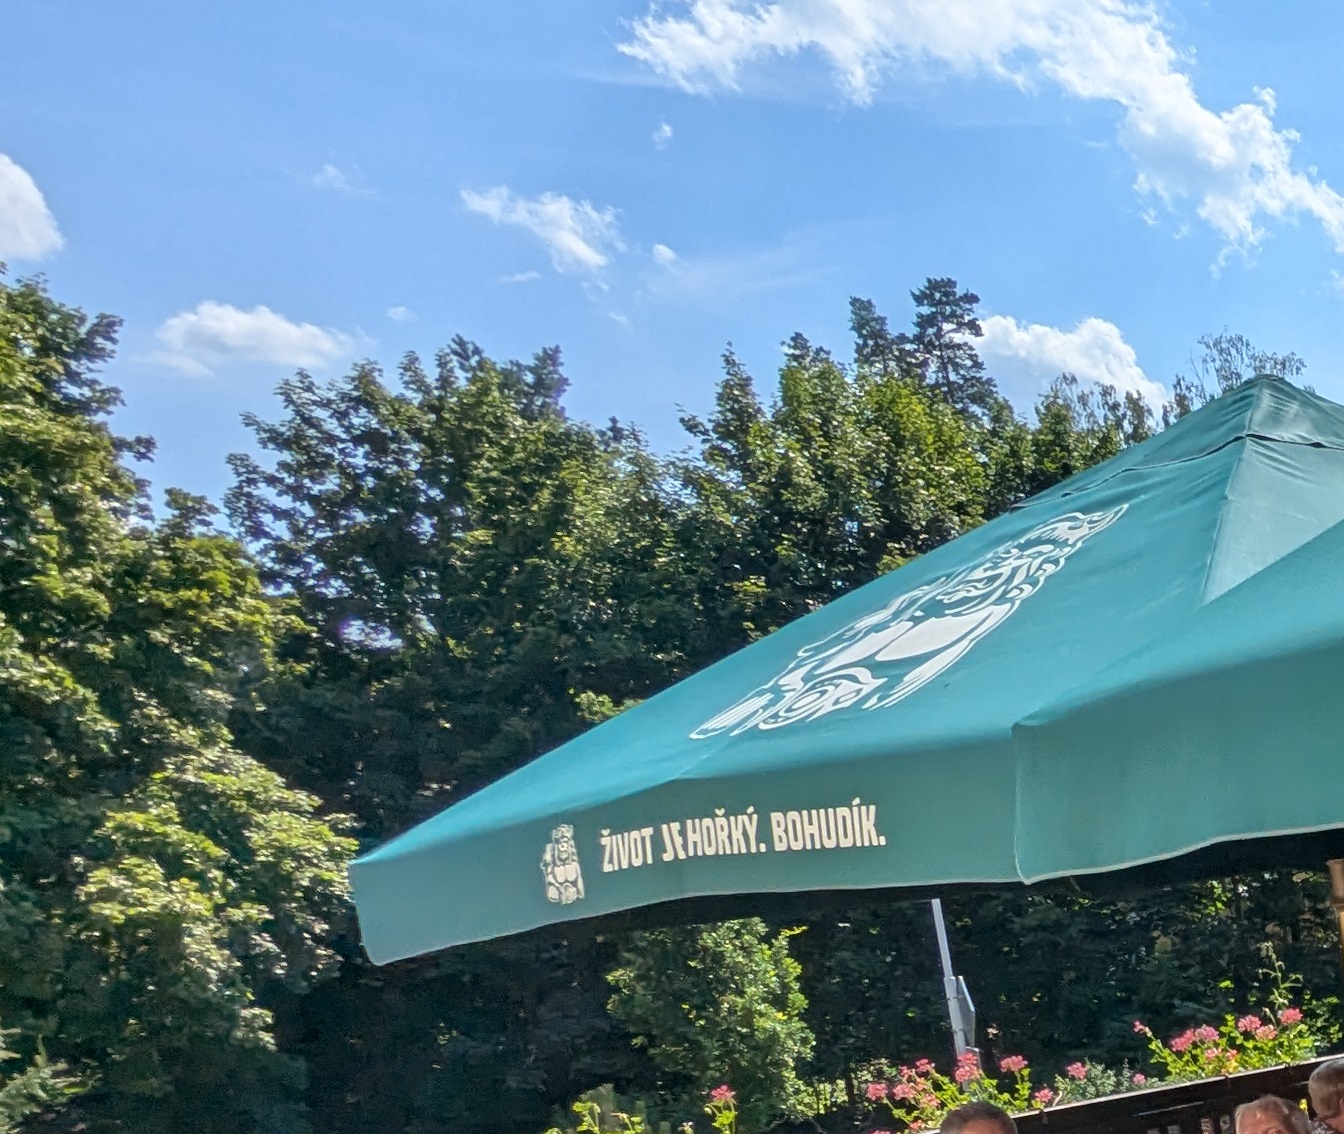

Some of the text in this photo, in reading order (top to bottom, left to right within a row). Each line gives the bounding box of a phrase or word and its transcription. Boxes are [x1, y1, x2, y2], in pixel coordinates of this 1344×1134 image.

[600, 797, 887, 873] ŽIVOT JE HOŘKÝ. BOHUDÍK.
